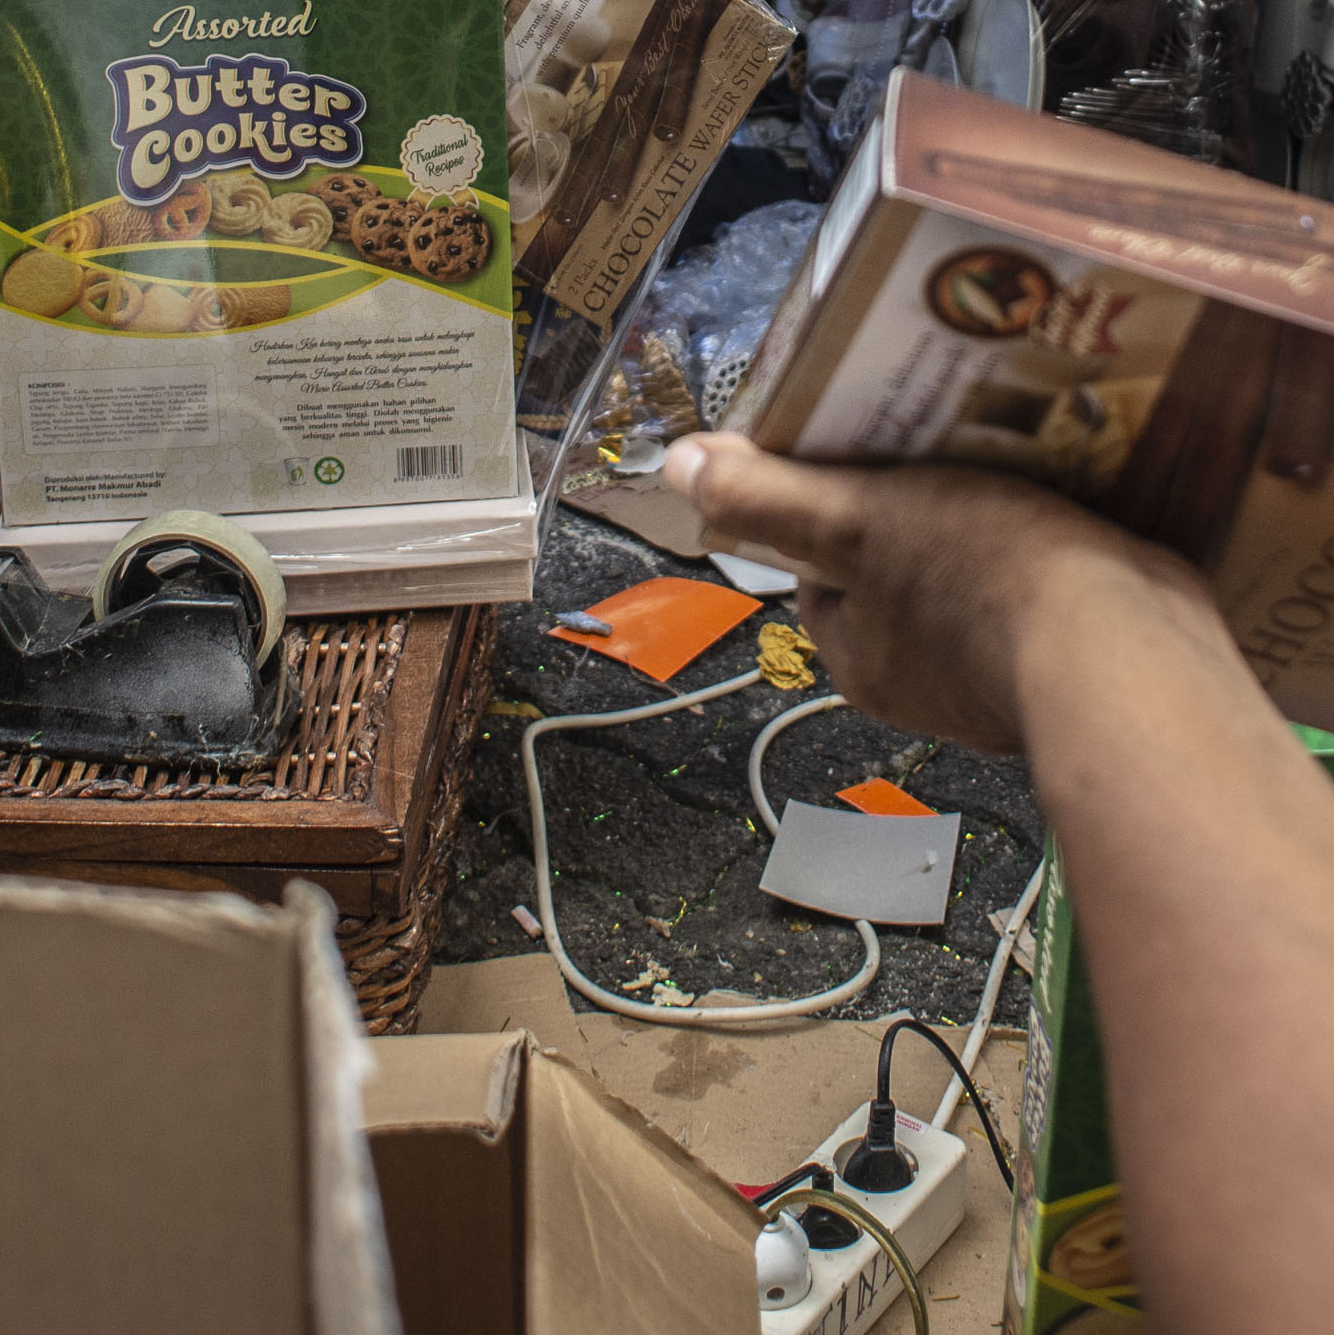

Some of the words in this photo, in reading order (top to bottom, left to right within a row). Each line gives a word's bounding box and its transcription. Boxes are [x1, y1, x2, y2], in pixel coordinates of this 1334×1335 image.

[151, 1, 318, 49] Assorted
[515, 10, 546, 50] Fragrant,
[533, 9, 565, 51] delightful
[535, 57, 552, 78] with
[547, 19, 577, 59] premium
[126, 61, 357, 132] Butter
[602, 71, 664, 138] Your
[635, 29, 676, 77] Best
[131, 111, 347, 189] Cookies
[410, 134, 469, 166] Traditional
[424, 153, 466, 179] Recipes
[579, 148, 701, 317] CHOCOLATE
[686, 87, 743, 158] WAFER
[729, 27, 781, 92] STICK
[572, 254, 600, 288] Packs
[566, 283, 581, 297] 2
[366, 379, 394, 390] Butter
[279, 415, 297, 423] yang
[301, 411, 342, 421] berkualitas
[346, 410, 369, 419] tinggi.
[374, 408, 399, 417] Diolah
[403, 405, 455, 416] menggunakan
[297, 402, 323, 411] Dibuat
[327, 400, 379, 410] menggunakan
[410, 396, 436, 405] pilihan
[283, 423, 305, 431] mesin
[309, 421, 338, 429] modern
[342, 419, 370, 428] melalui
[374, 419, 398, 428] proses
[402, 418, 420, 426] yang
[424, 415, 452, 423] higienis
[302, 431, 335, 441] sehingga
[339, 430, 360, 438] aman
[363, 428, 385, 436] untuk
[389, 426, 433, 435] dikonsumsi.
[44, 475, 84, 484] Diproduksi
[46, 485, 58, 493] PT.
[60, 484, 97, 492] Monarre
[98, 482, 134, 491] Makmur
[46, 494, 86, 503] Tangerang
[111, 491, 148, 499] Indonesia
